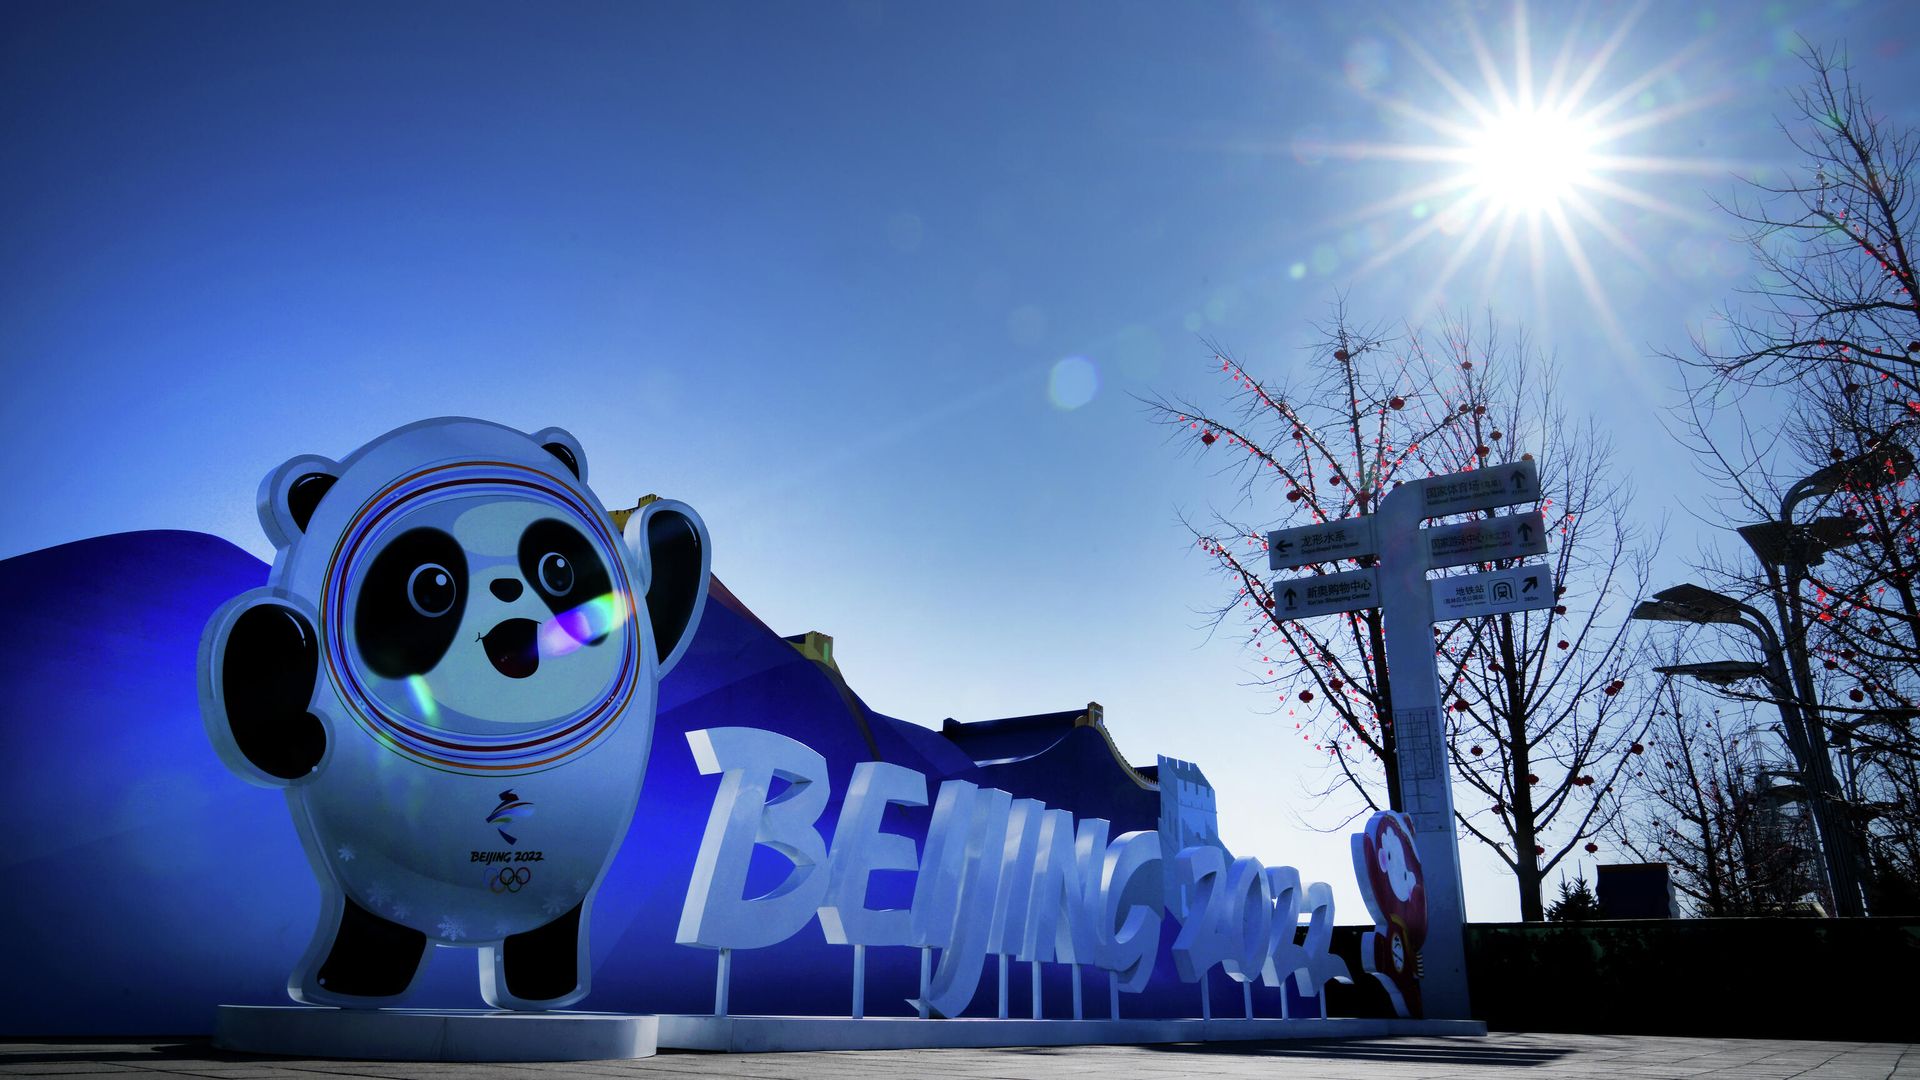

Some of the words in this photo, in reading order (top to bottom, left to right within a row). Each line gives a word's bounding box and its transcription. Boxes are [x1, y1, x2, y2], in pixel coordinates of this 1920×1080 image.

[1301, 529, 1345, 547] 龙形水系
[1307, 579, 1372, 598] 新奥购物中心
[1456, 584, 1484, 596] 地铁站
[470, 851, 512, 865] BEIJING
[513, 850, 545, 862] 2022
[675, 725, 1162, 1019] BEIJING
[1172, 846, 1354, 998] 2022
